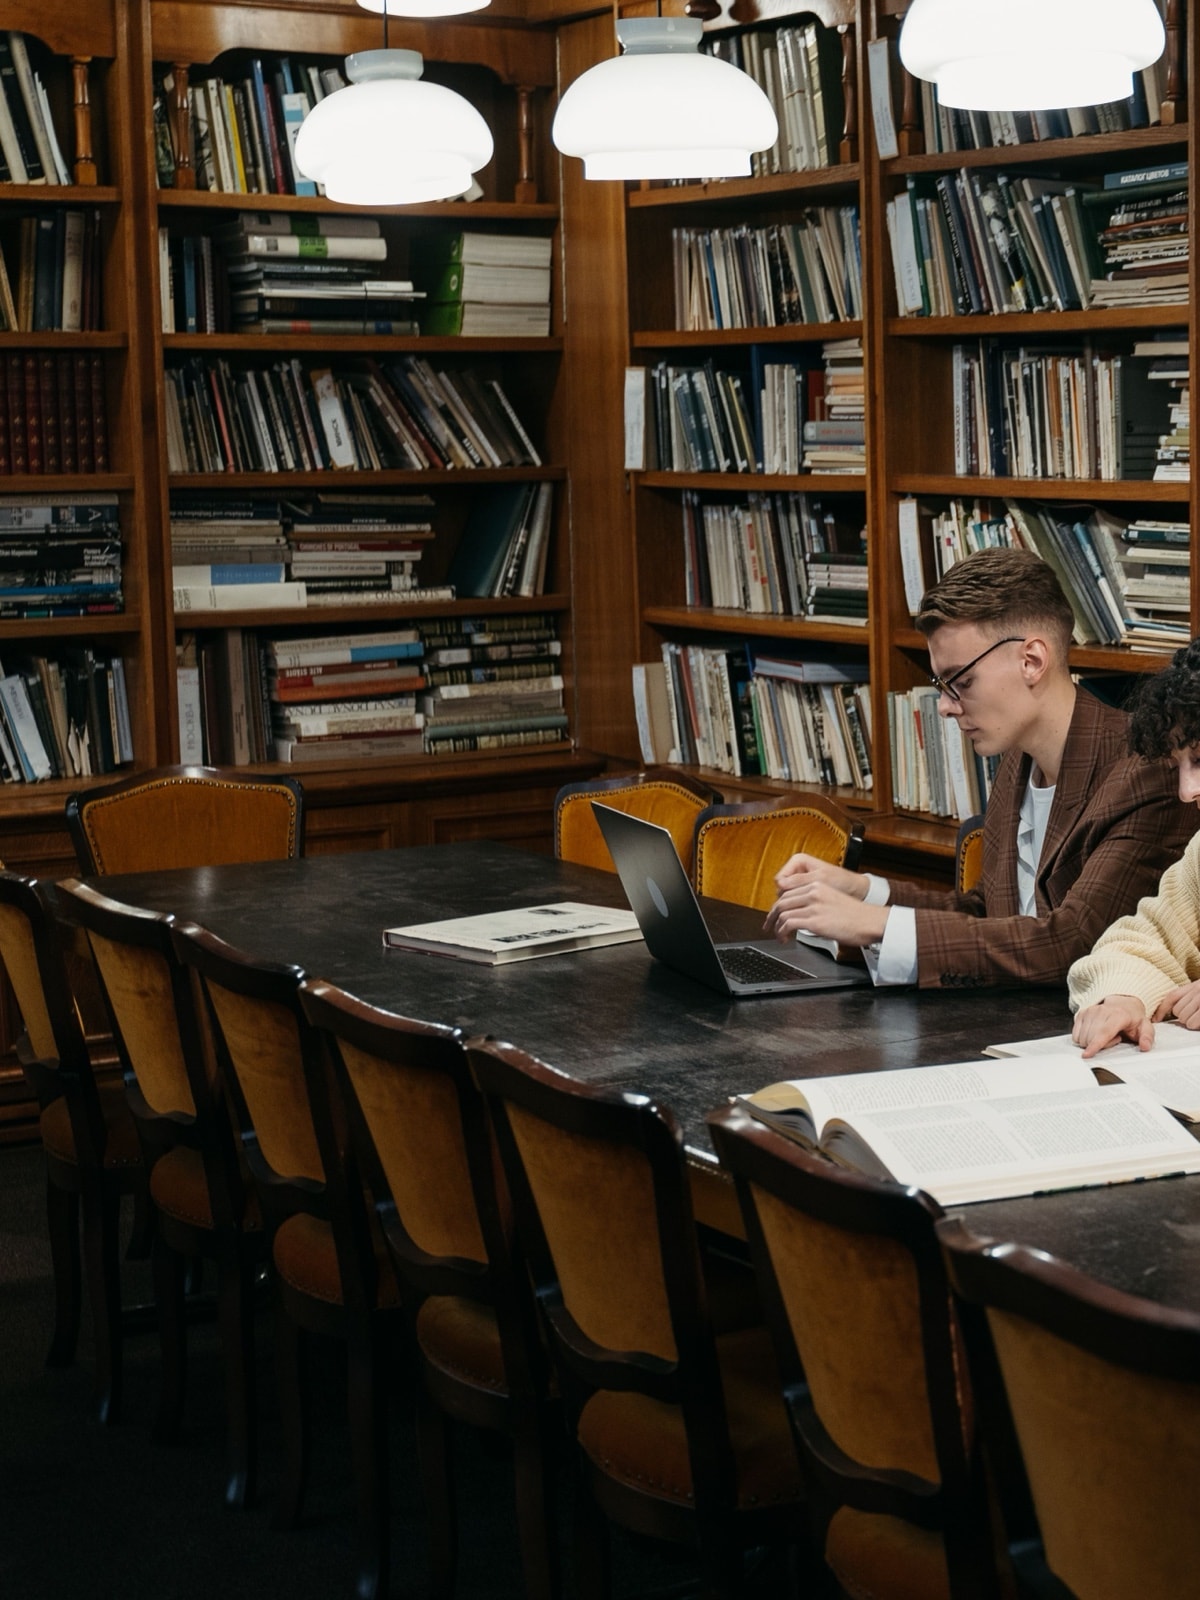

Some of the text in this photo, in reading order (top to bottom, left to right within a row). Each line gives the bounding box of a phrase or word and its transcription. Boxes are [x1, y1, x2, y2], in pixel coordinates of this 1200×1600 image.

[1121, 169, 1169, 184] КАТАЛОГ ЦВЕТОВ
[309, 666, 323, 676] ALTE
